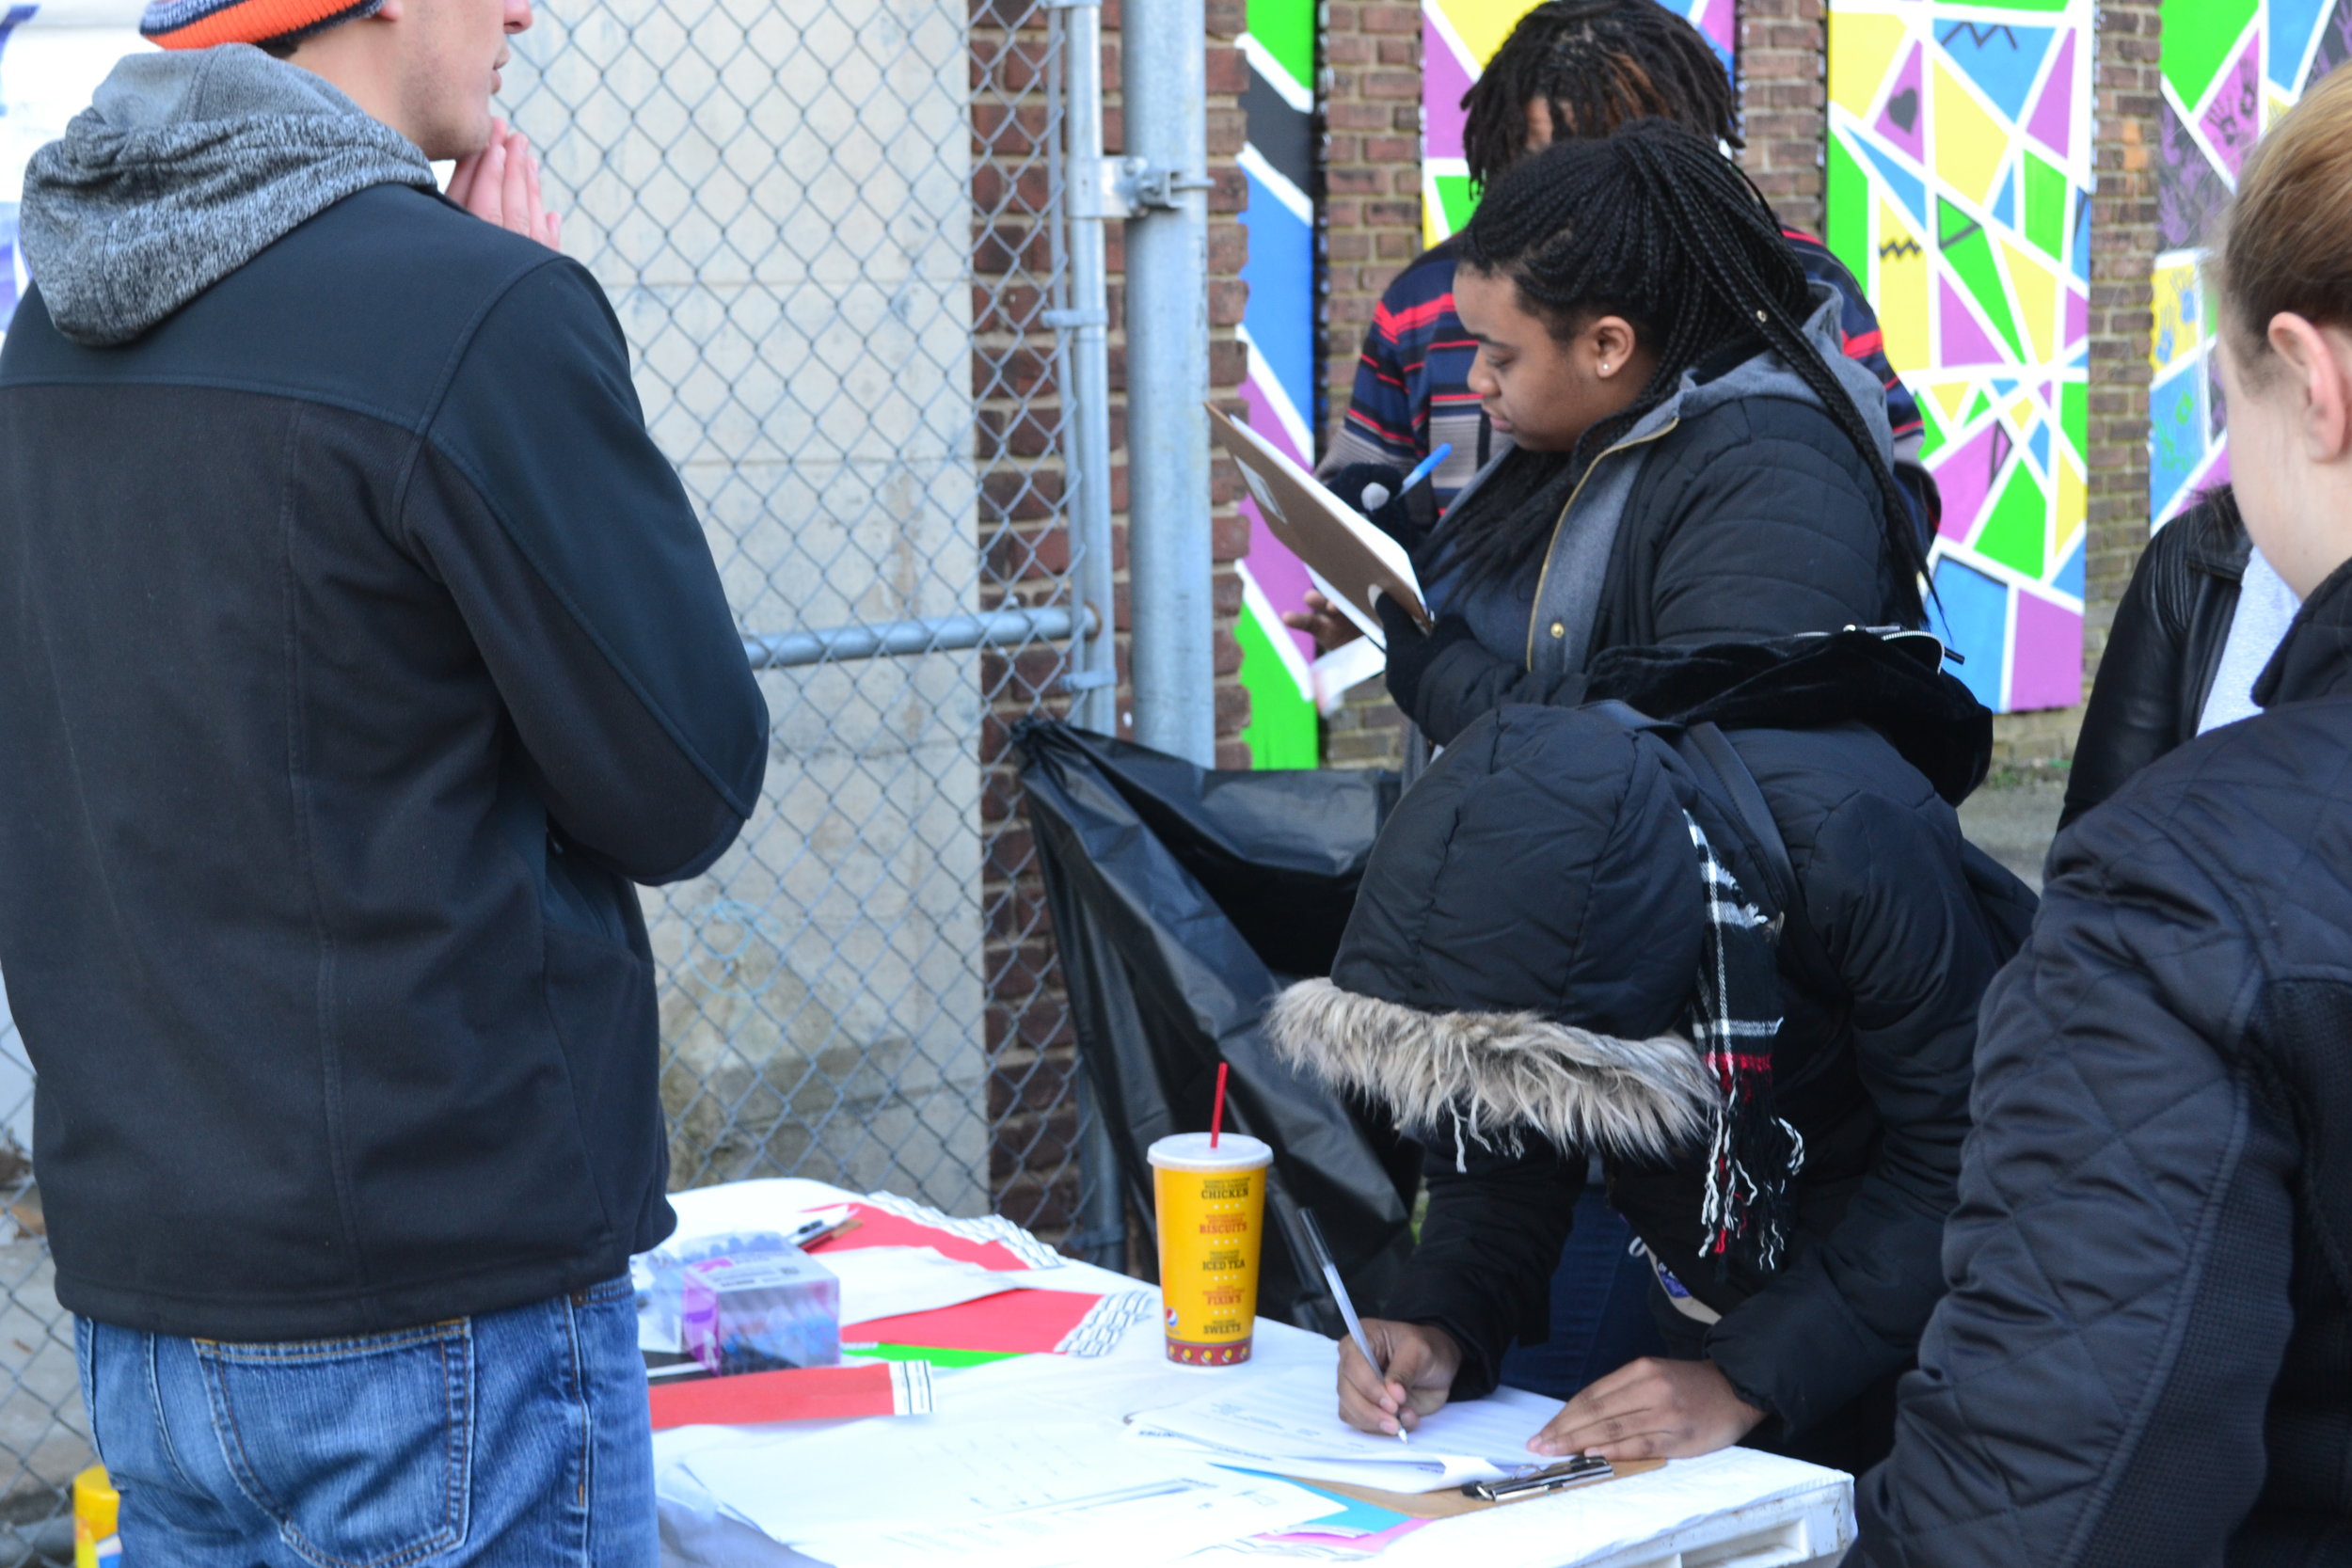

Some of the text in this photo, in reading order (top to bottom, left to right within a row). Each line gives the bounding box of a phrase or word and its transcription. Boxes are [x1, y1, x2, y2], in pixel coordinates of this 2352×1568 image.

[1201, 1188, 1248, 1199] CHICKEN
[1200, 1222, 1247, 1234] BISCUITS
[1203, 1261, 1226, 1271] ICED
[1227, 1259, 1245, 1270] TEA
[1203, 1323, 1241, 1335] SWEETS
